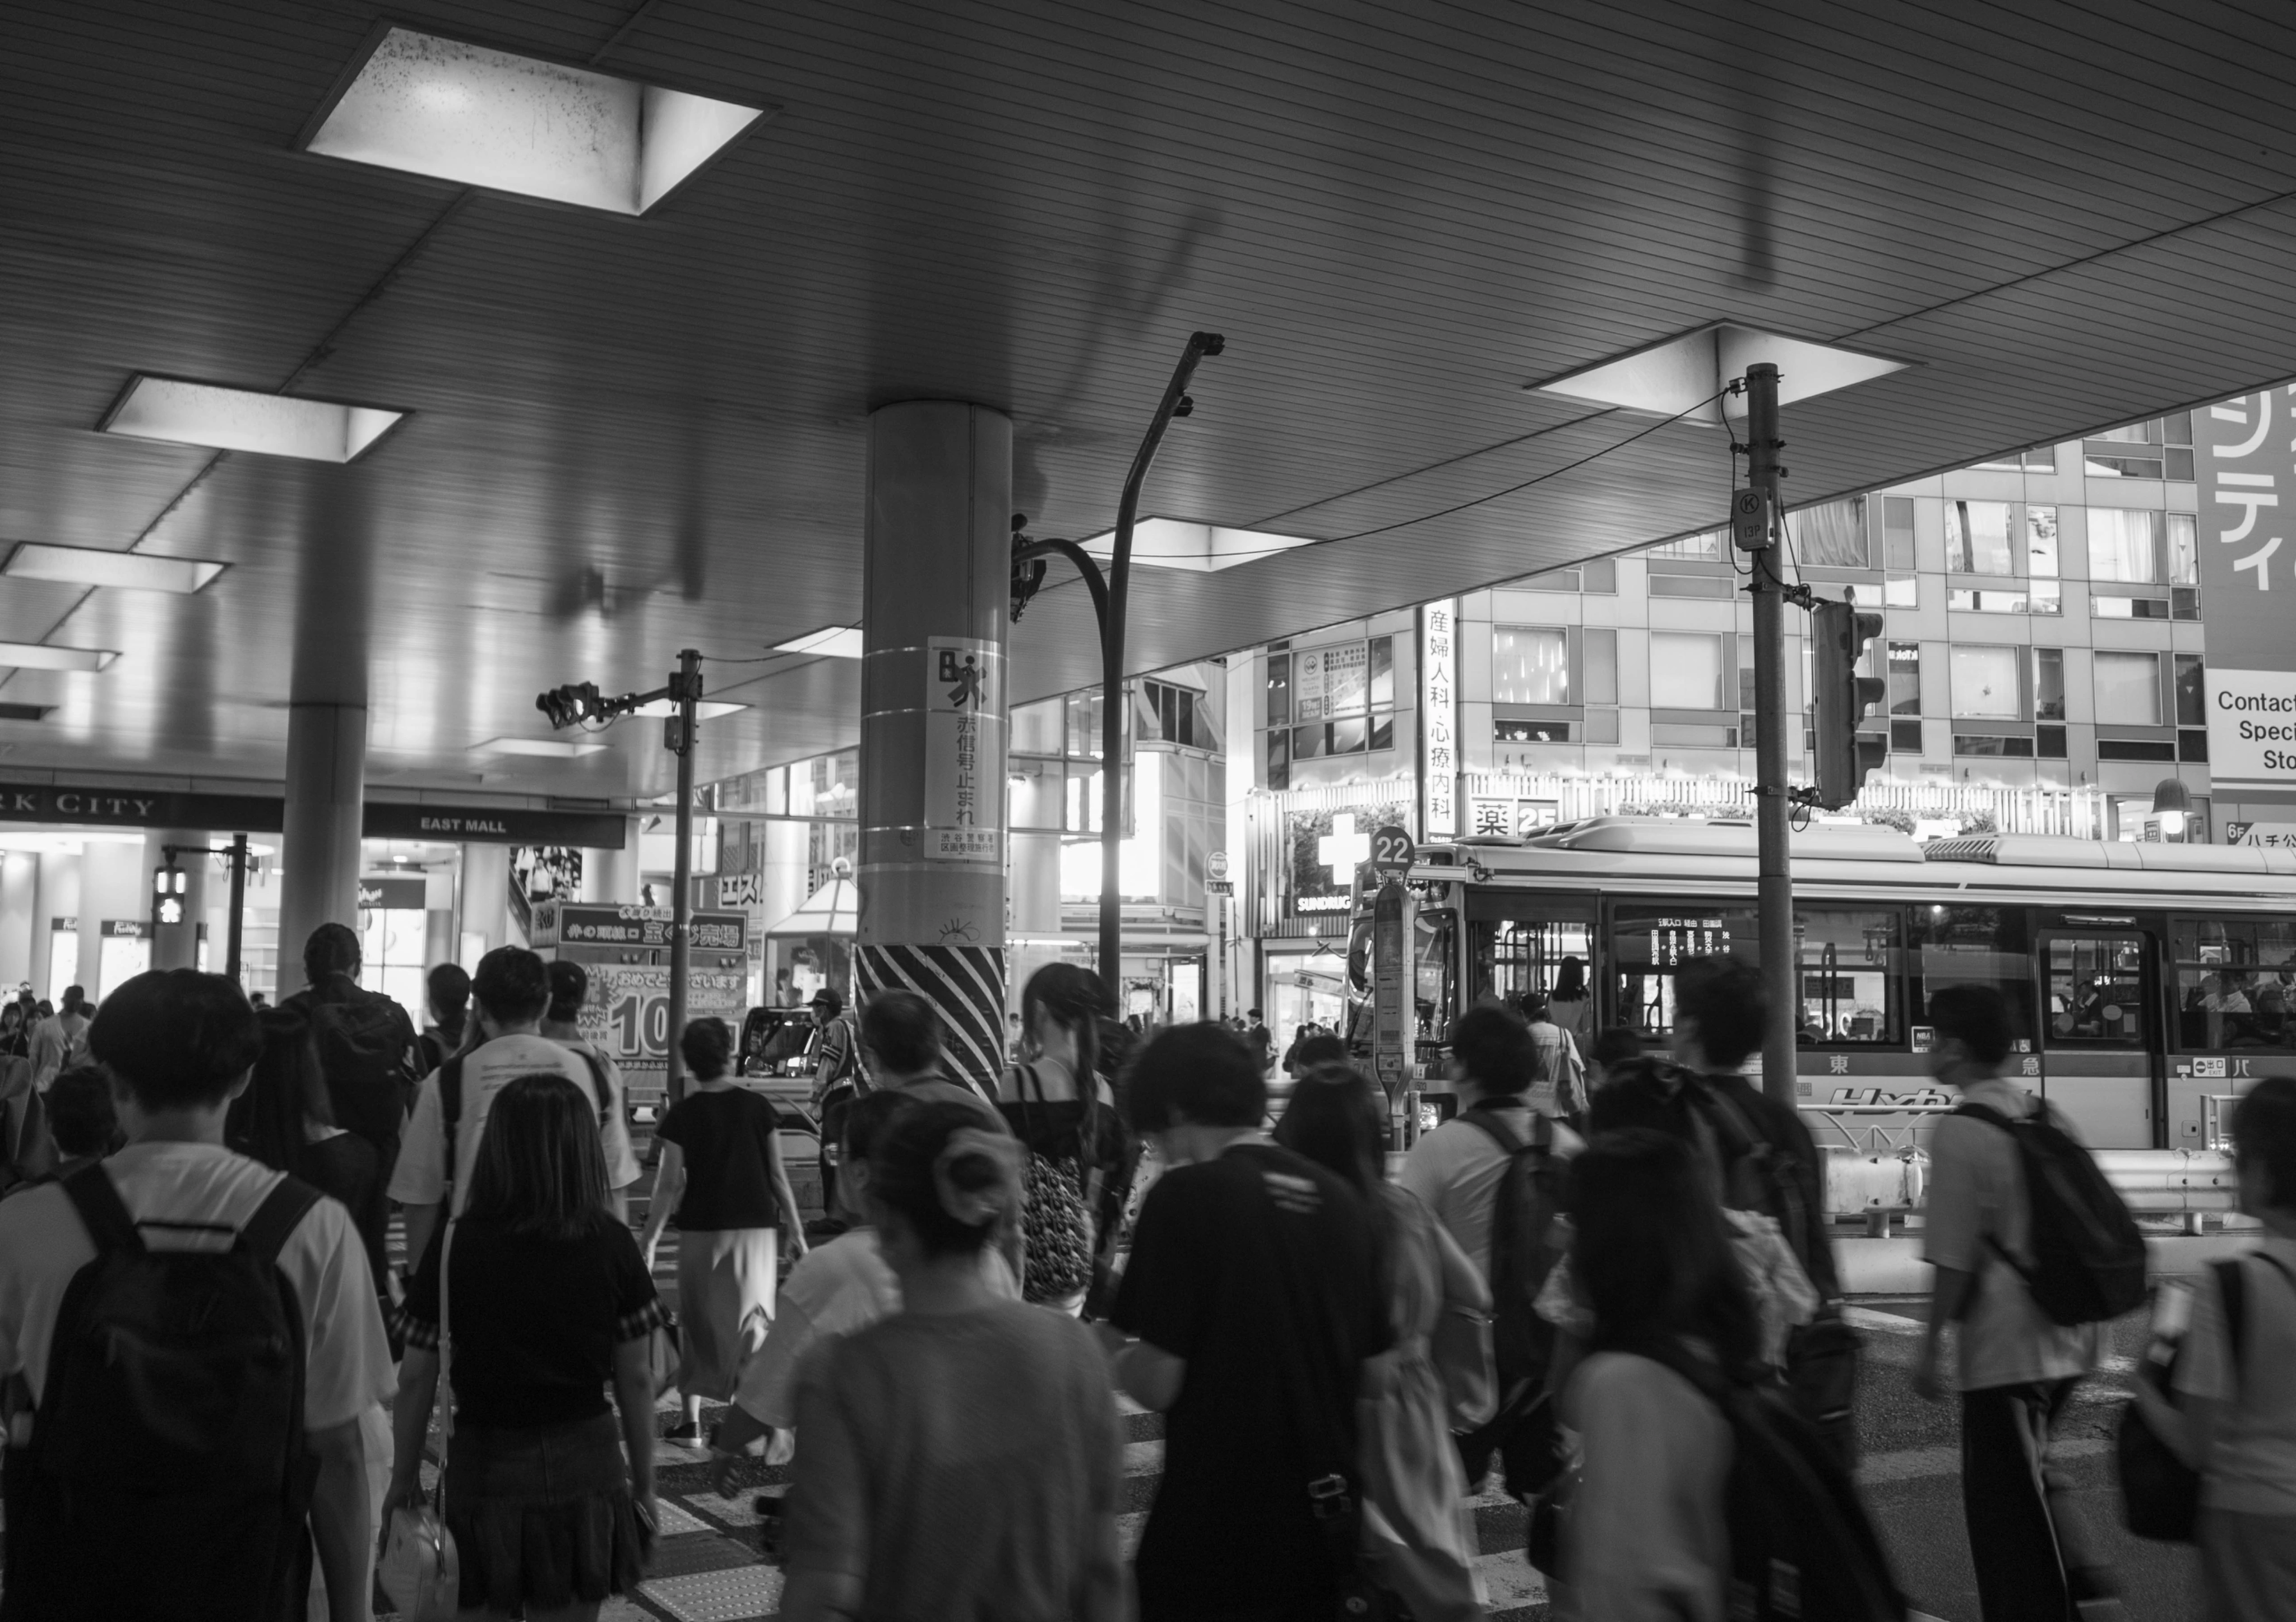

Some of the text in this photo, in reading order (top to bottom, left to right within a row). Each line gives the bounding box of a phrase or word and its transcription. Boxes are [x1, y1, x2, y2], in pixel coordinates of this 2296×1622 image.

[956, 716, 976, 826] 赤信号止まれ
[0, 791, 154, 816] K CITY
[421, 817, 506, 833] EAST MALL
[1476, 804, 1508, 835] 薬
[2228, 823, 2244, 838] 6F
[1377, 836, 1408, 863] 22
[1298, 895, 1351, 911] SUNDRUG
[2207, 1060, 2223, 1069] 出口
